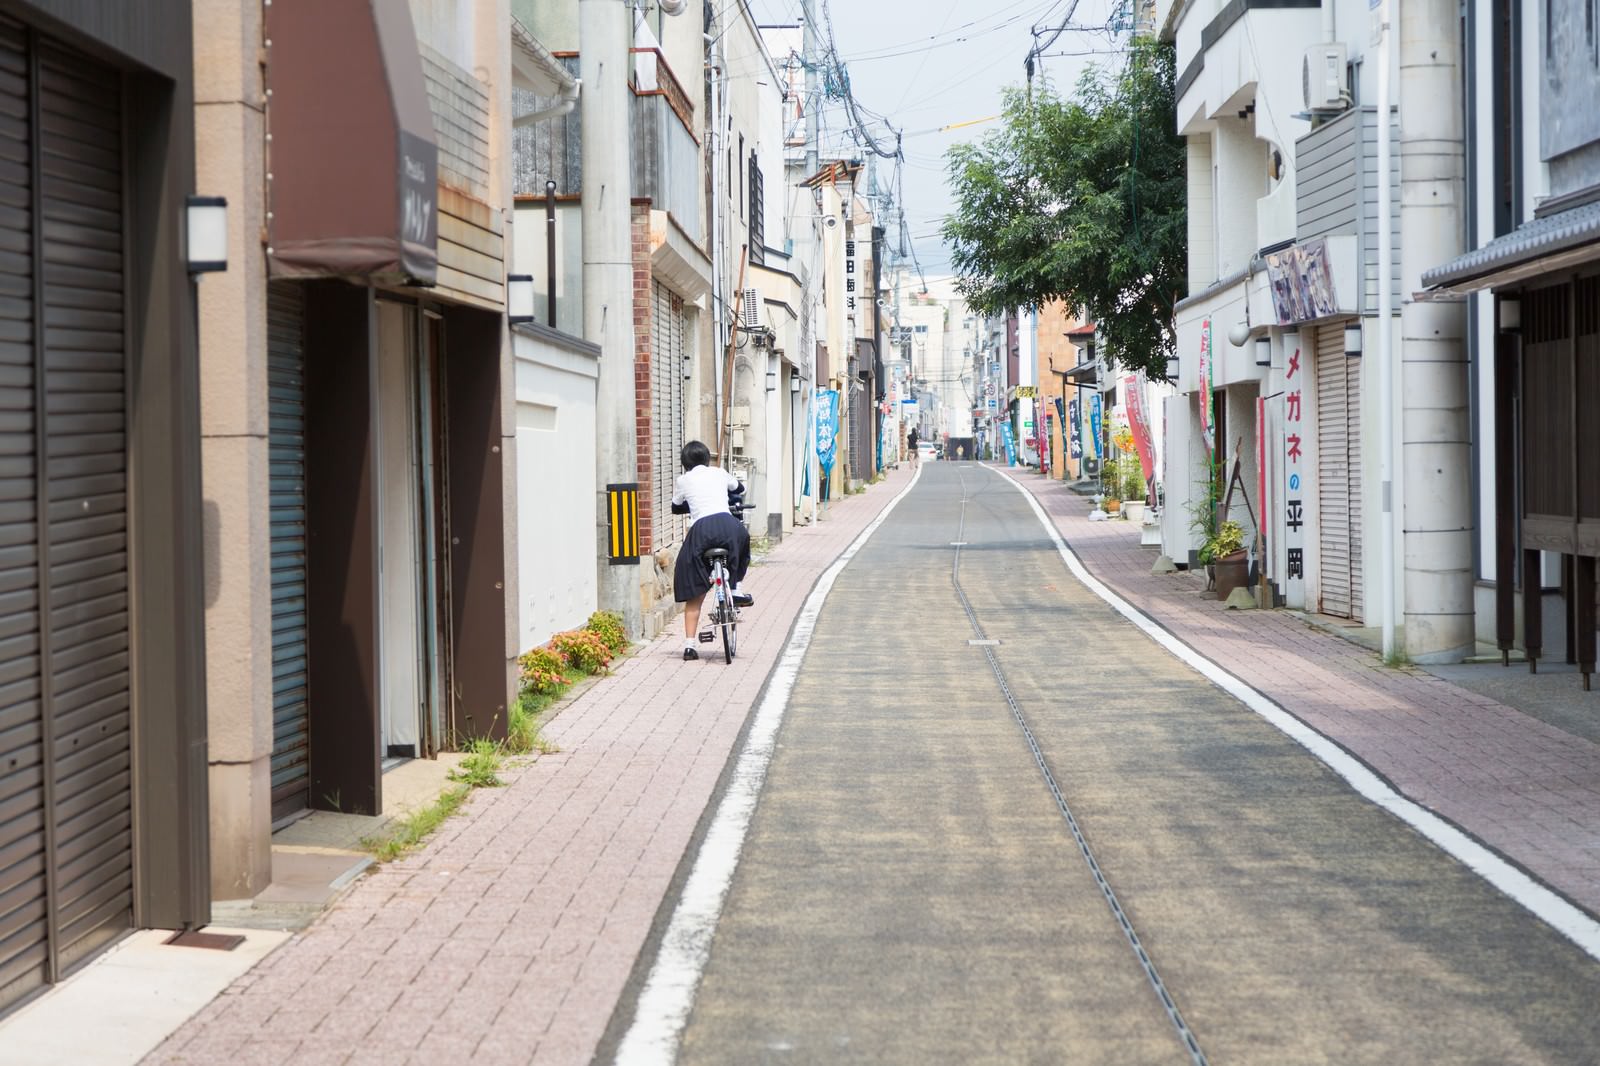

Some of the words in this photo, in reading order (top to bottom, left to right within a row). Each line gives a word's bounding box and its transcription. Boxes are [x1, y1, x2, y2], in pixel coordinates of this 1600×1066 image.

[1286, 348, 1304, 580] メガネの平岡
